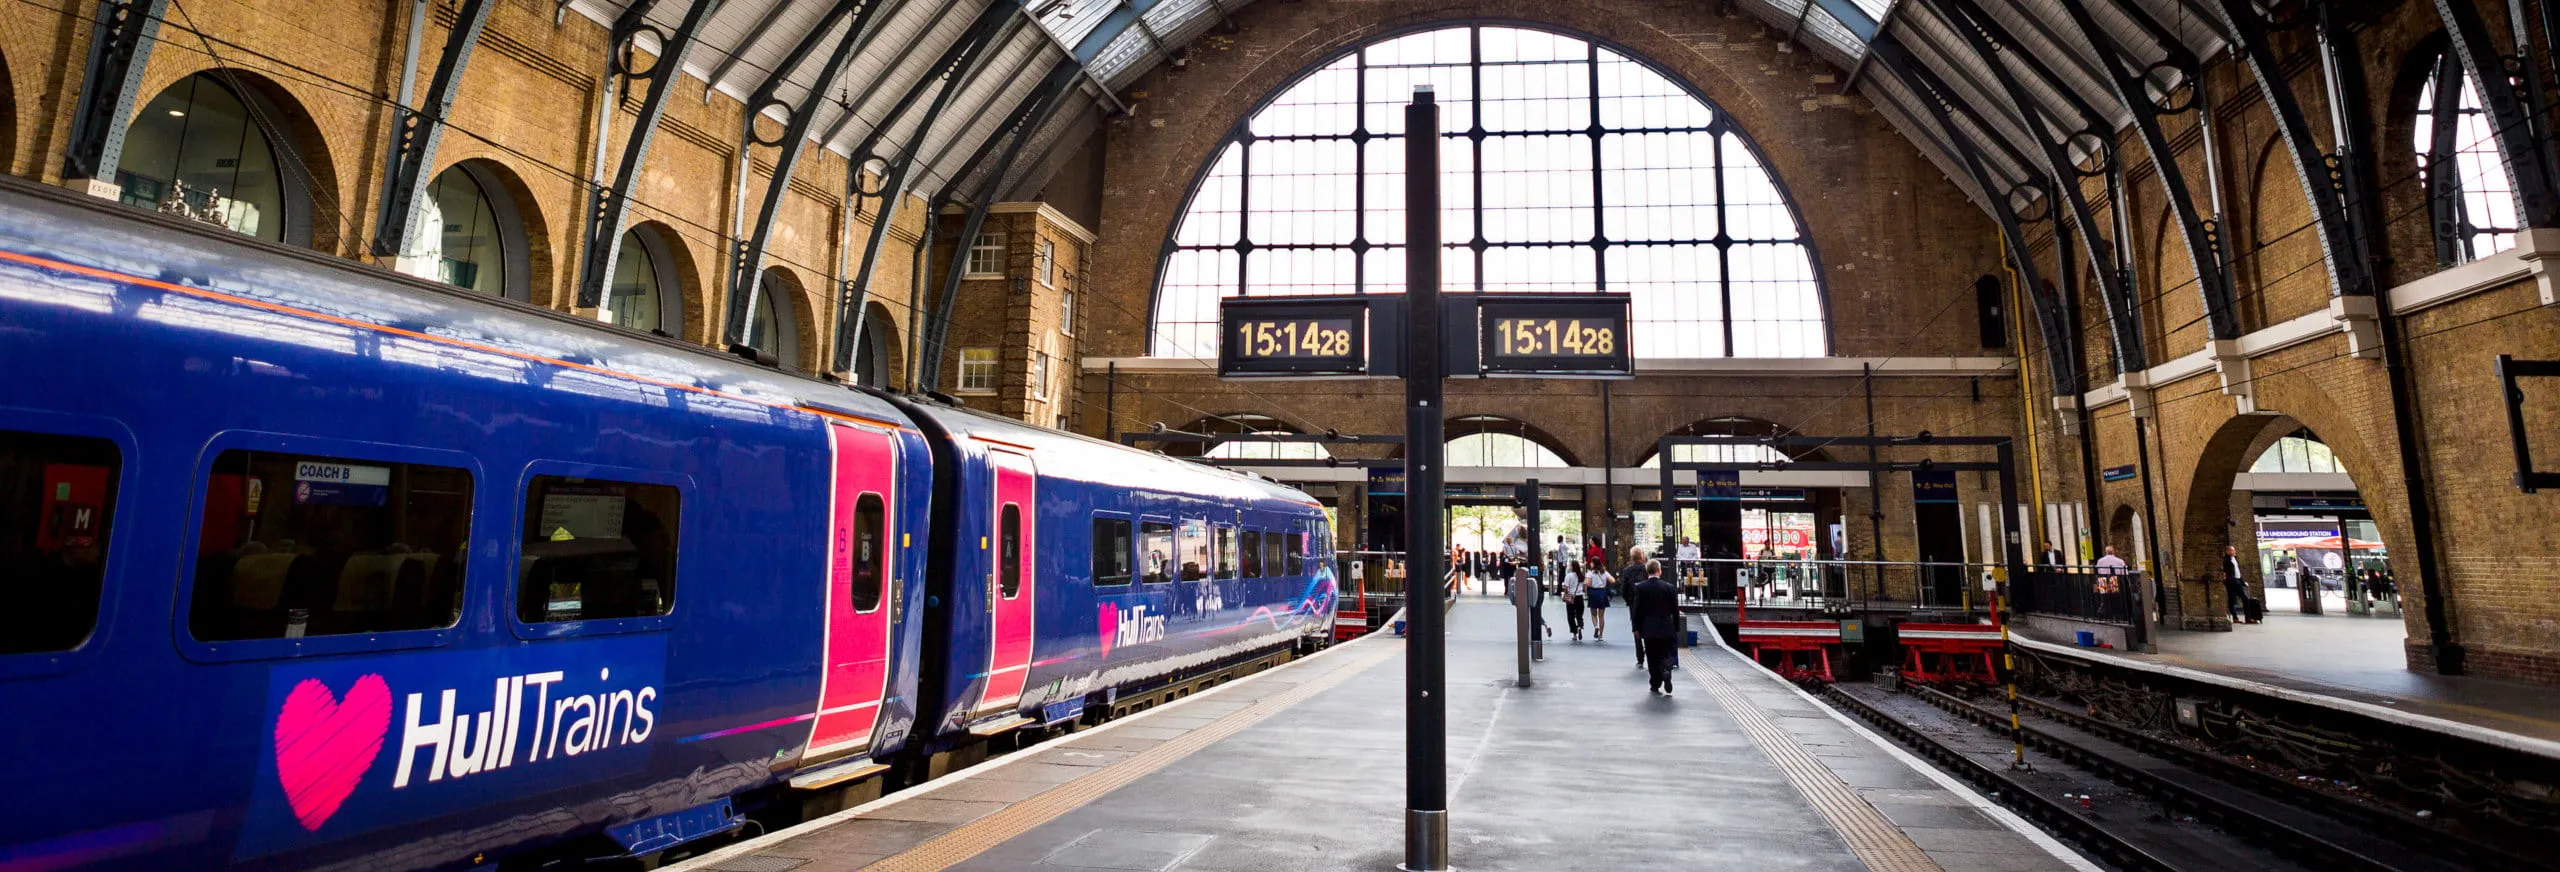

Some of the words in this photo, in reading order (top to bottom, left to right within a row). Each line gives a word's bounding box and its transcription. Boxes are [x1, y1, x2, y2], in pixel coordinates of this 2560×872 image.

[300, 464, 339, 479] COACH
[342, 467, 350, 479] B
[75, 508, 91, 530] M
[840, 528, 846, 552] B
[862, 540, 871, 561] B
